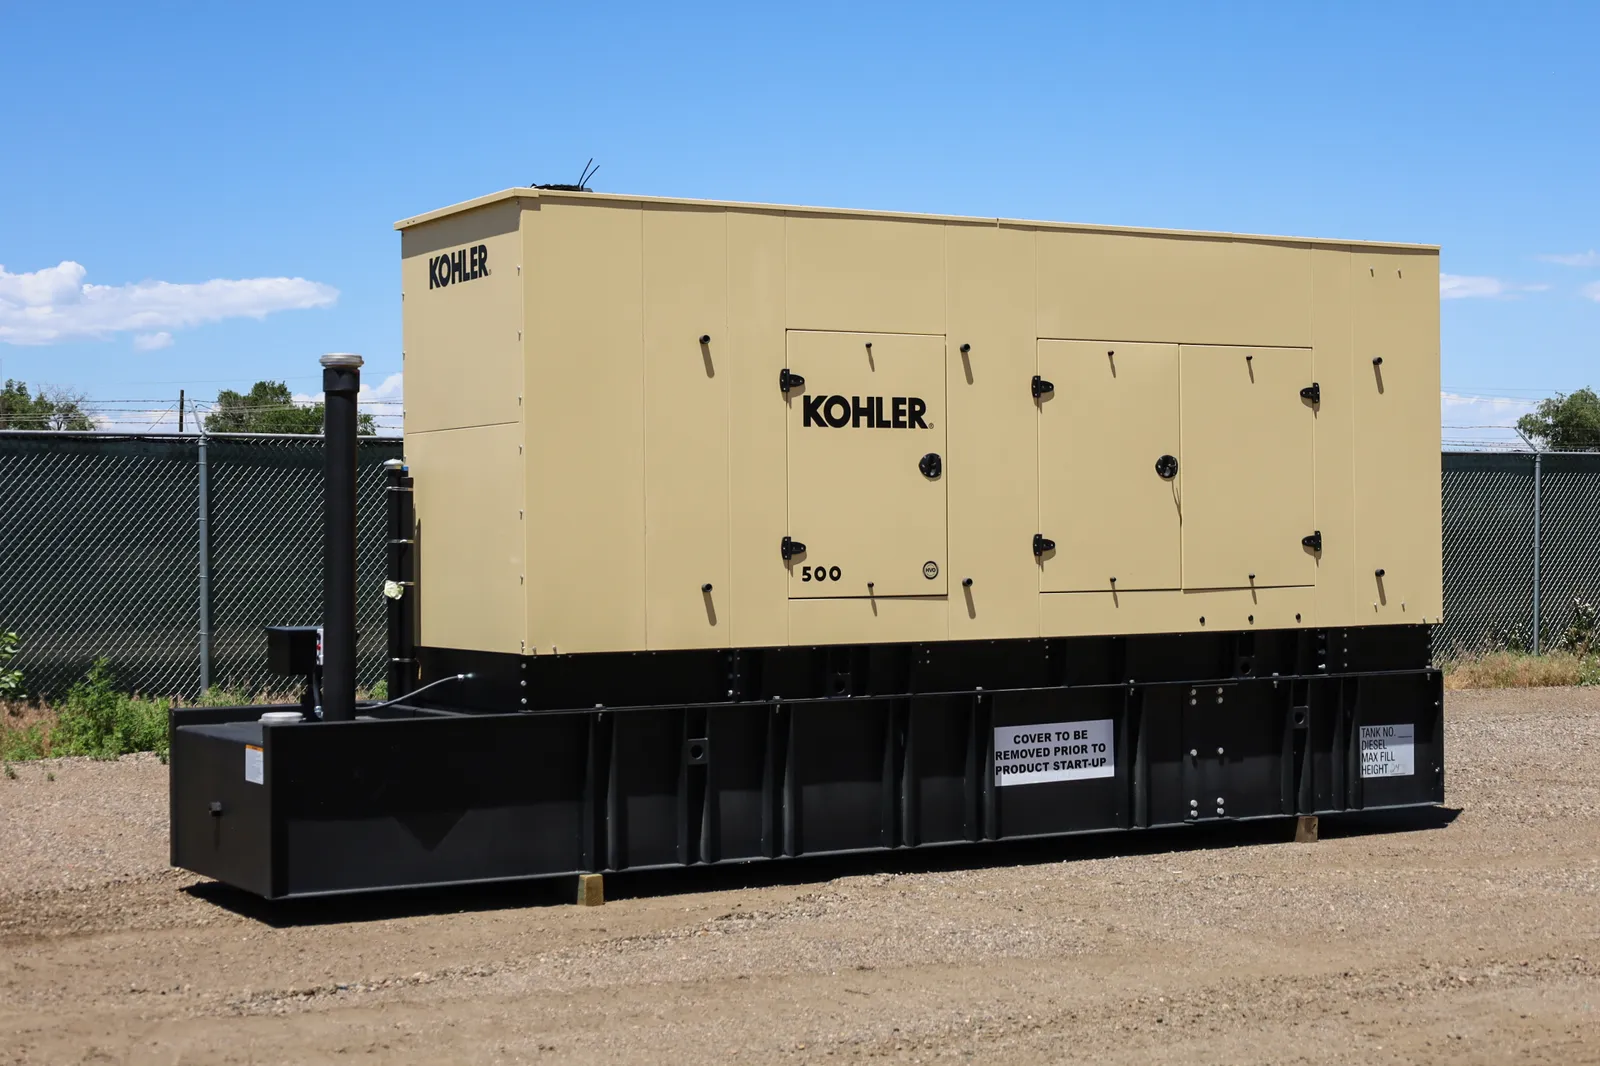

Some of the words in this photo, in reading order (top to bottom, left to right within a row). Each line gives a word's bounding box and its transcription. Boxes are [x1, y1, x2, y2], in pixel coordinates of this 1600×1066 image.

[429, 244, 488, 290] KOHLER
[803, 395, 928, 429] KOHLER
[802, 566, 841, 582] 500
[1013, 733, 1052, 745] COVER
[1055, 731, 1070, 742] TO
[1073, 729, 1088, 740] BE
[1361, 727, 1381, 738] TANK
[1383, 727, 1396, 737] NO.
[995, 747, 1050, 761] REMOVED
[1054, 744, 1088, 756] PRIOR
[1091, 743, 1106, 753] TO
[1361, 739, 1387, 750] DIESEL
[1361, 752, 1378, 763] MAX
[1380, 751, 1395, 762] FILL
[995, 762, 1049, 776] PRODUCT
[1053, 757, 1106, 771] START-UP
[1361, 764, 1388, 775] HEIGHT
